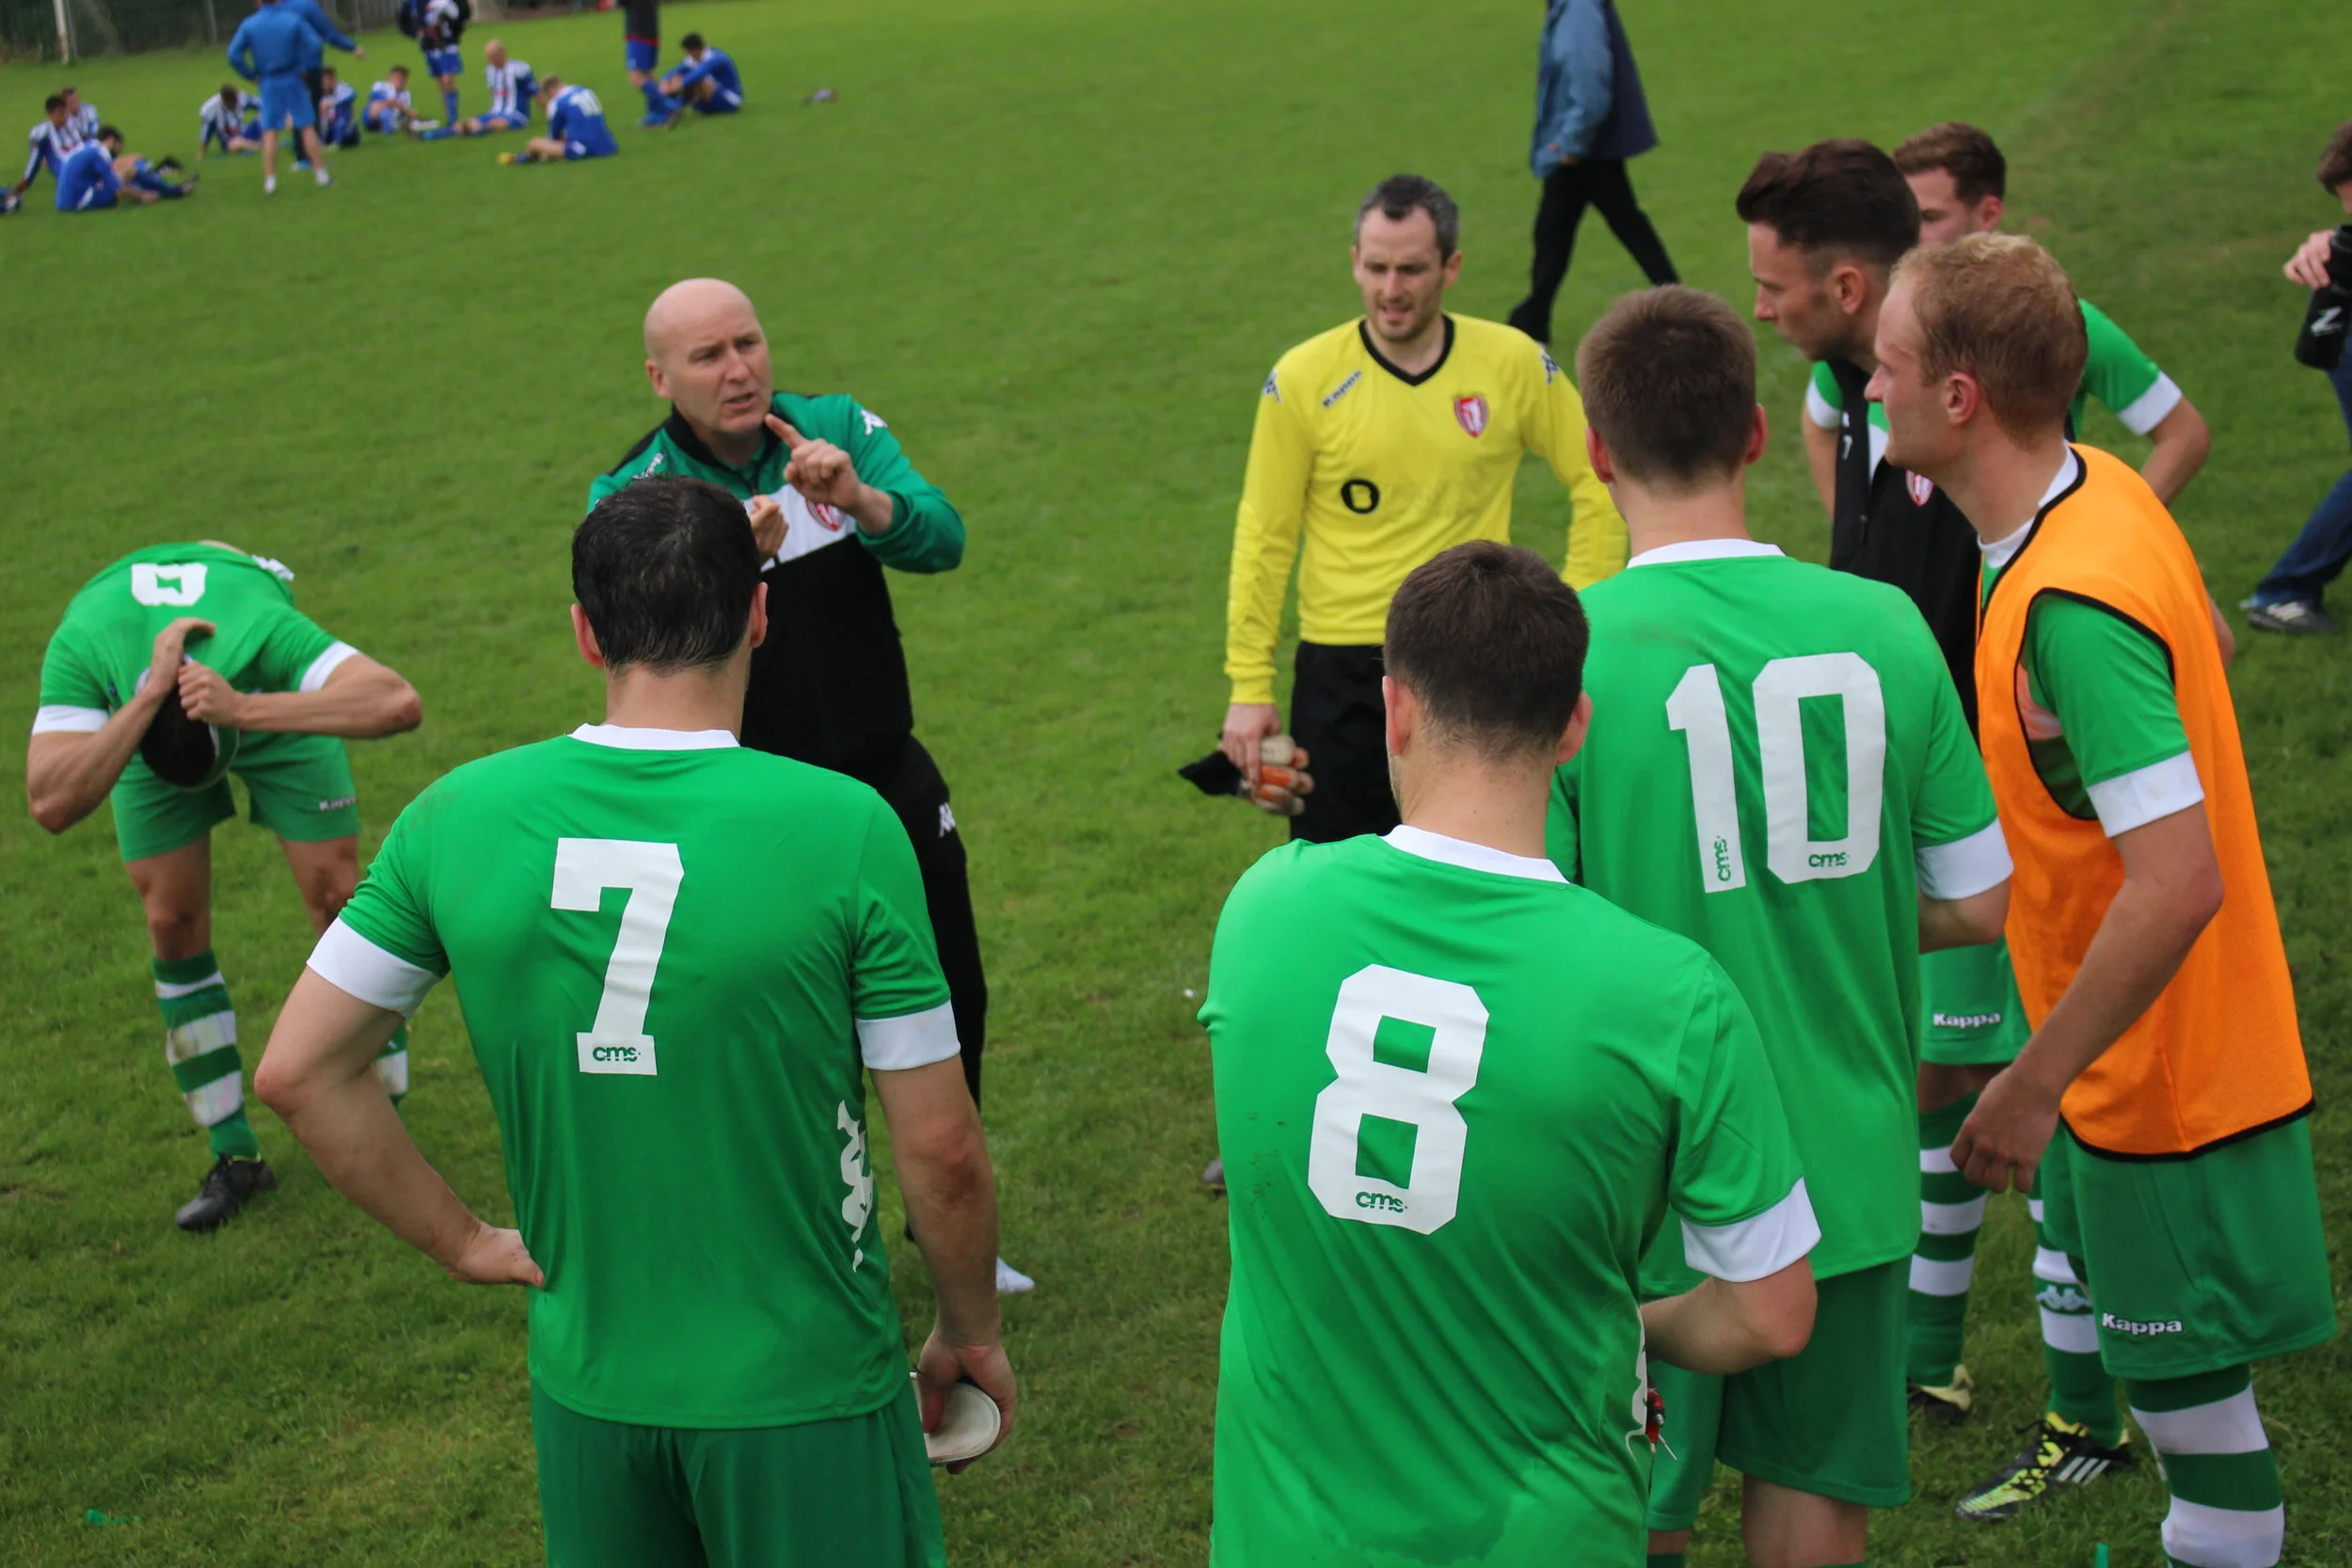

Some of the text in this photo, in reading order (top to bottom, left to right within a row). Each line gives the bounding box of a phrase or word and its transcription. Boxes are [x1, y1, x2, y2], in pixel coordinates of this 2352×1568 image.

[1666, 653, 1885, 893] 10
[1807, 851, 1850, 867] cms
[550, 837, 685, 1076] 7
[1933, 1012, 2001, 1029] Kappa
[592, 1046, 641, 1063] cms
[1308, 963, 1490, 1235] 8
[1355, 1191, 1407, 1213] cms
[2102, 1312, 2184, 1337] Kappa
